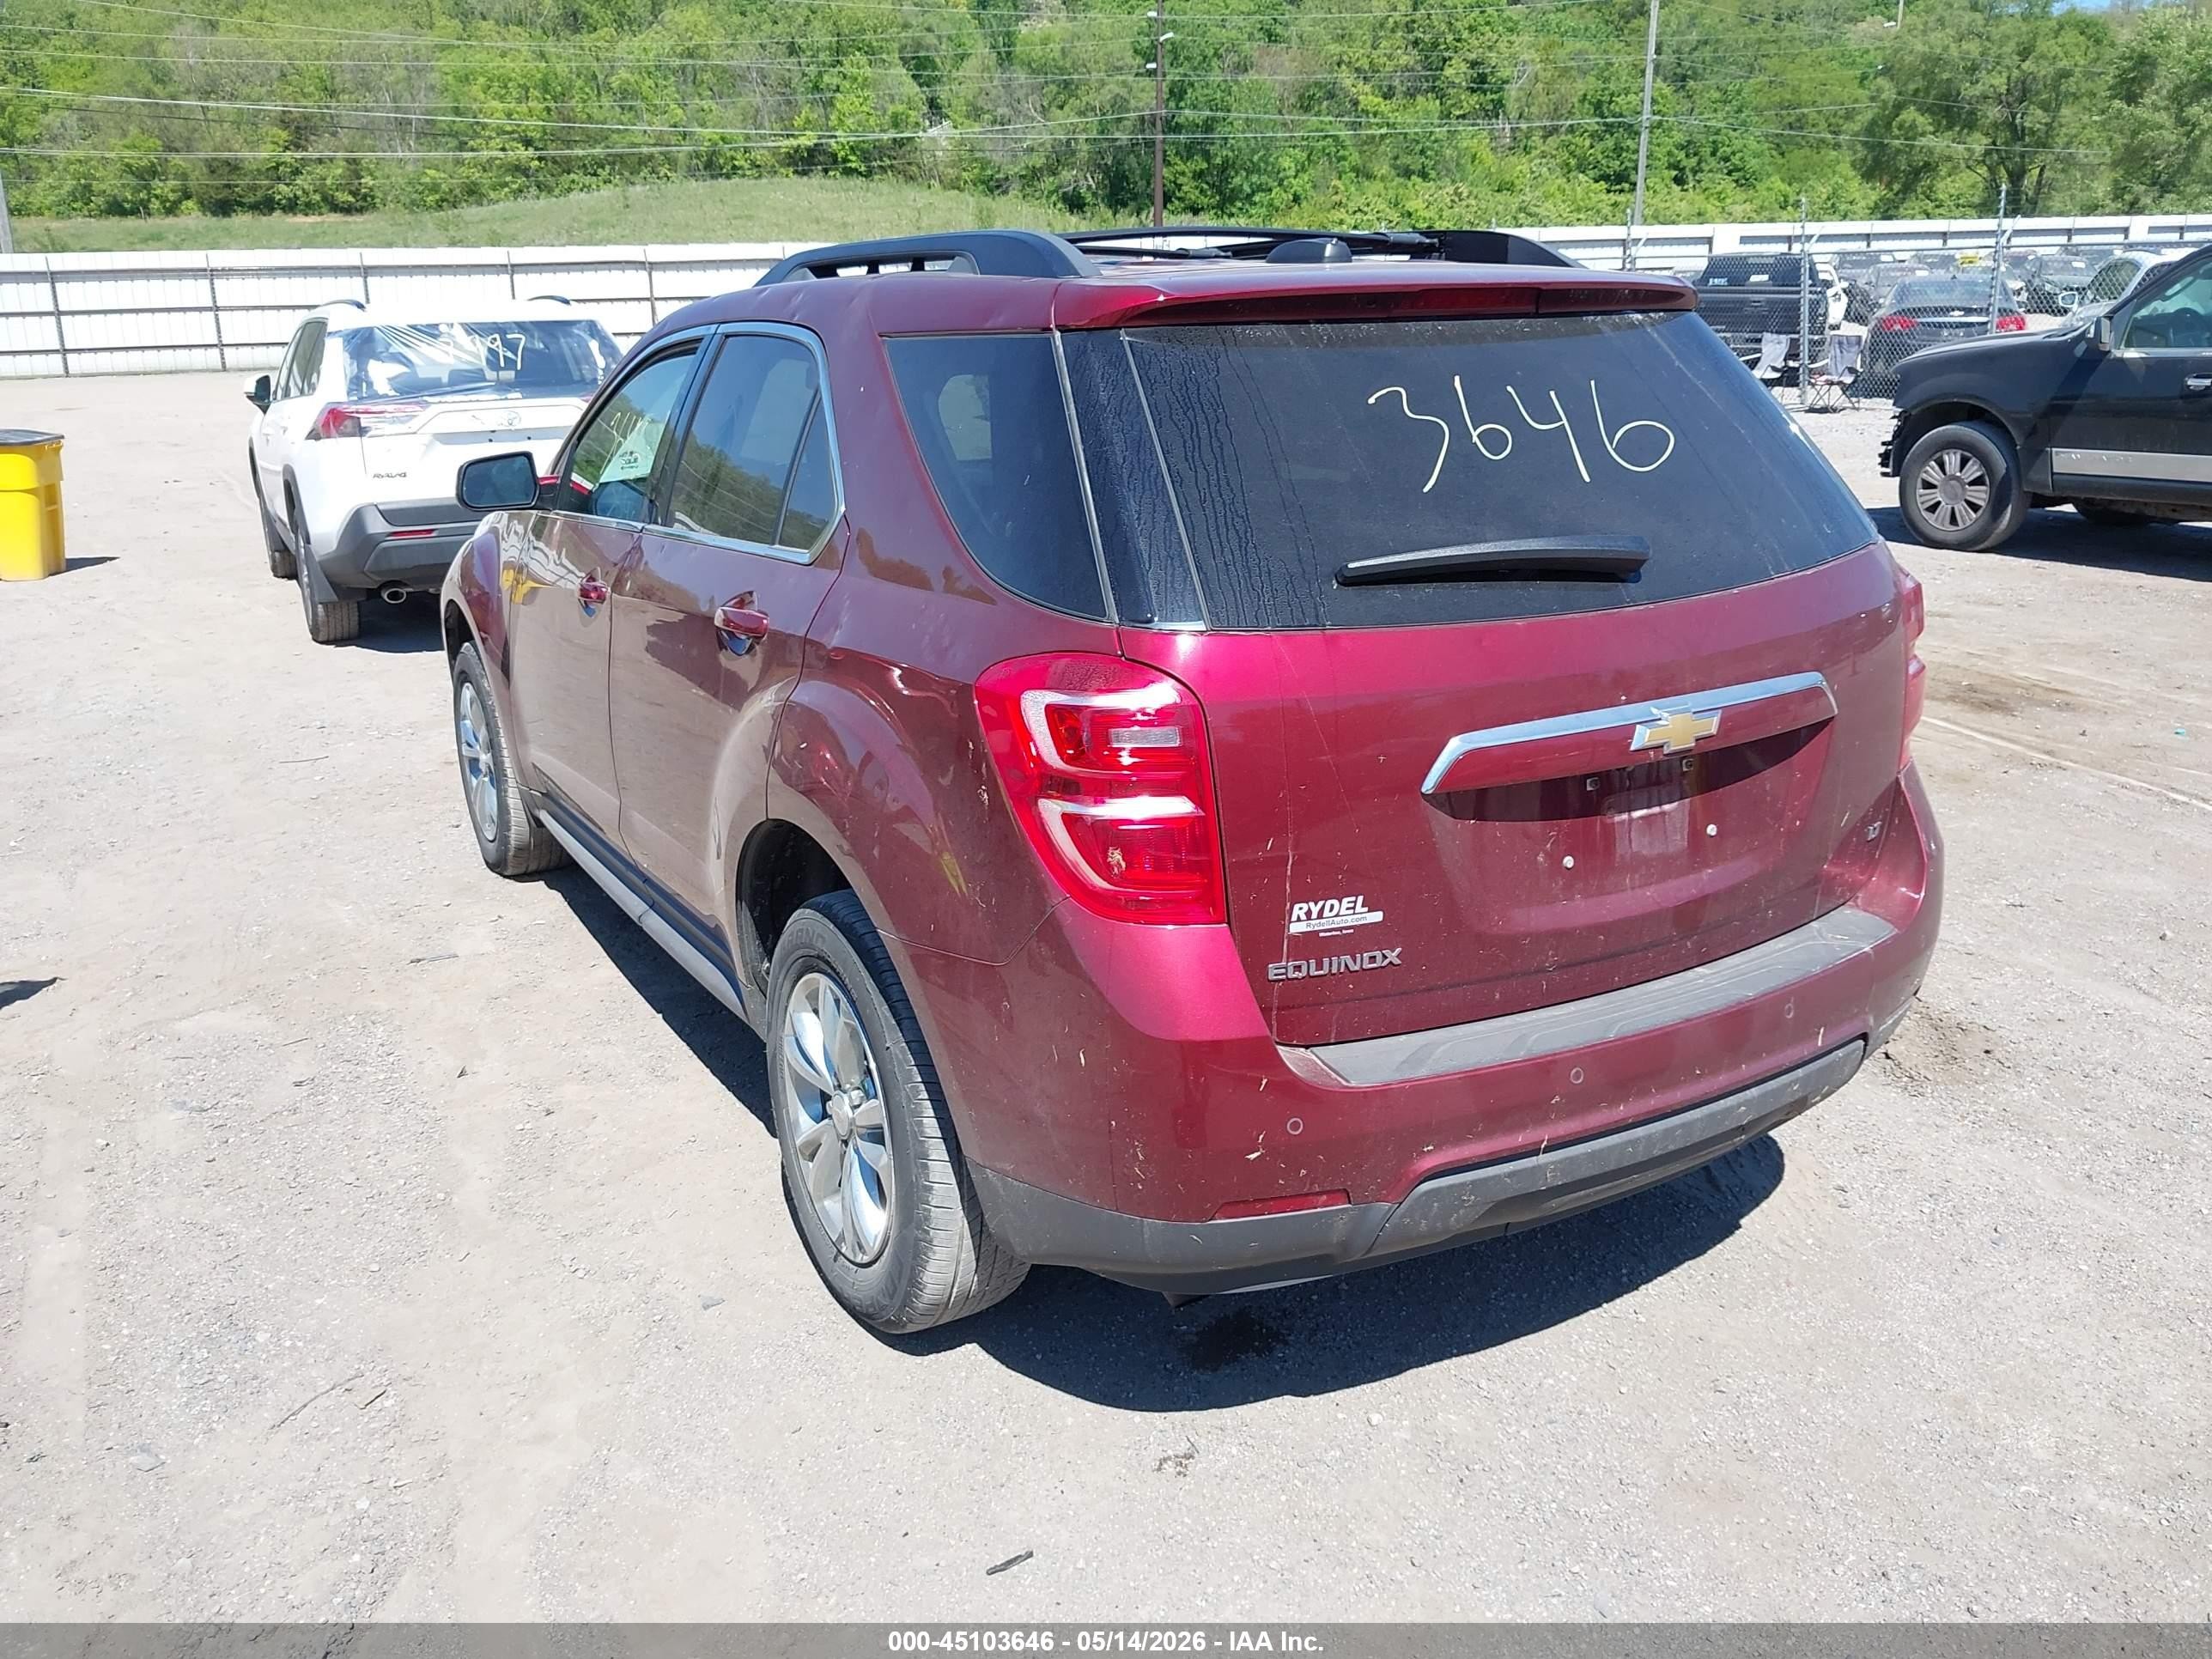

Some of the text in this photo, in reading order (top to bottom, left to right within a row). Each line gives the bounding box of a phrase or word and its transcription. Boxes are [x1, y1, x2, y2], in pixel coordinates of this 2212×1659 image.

[1367, 374, 1675, 493] 3646
[1291, 895, 1369, 922] RYDEL
[1305, 915, 1368, 930] RydellAuto.com
[1267, 947, 1402, 982] EQUINOX
